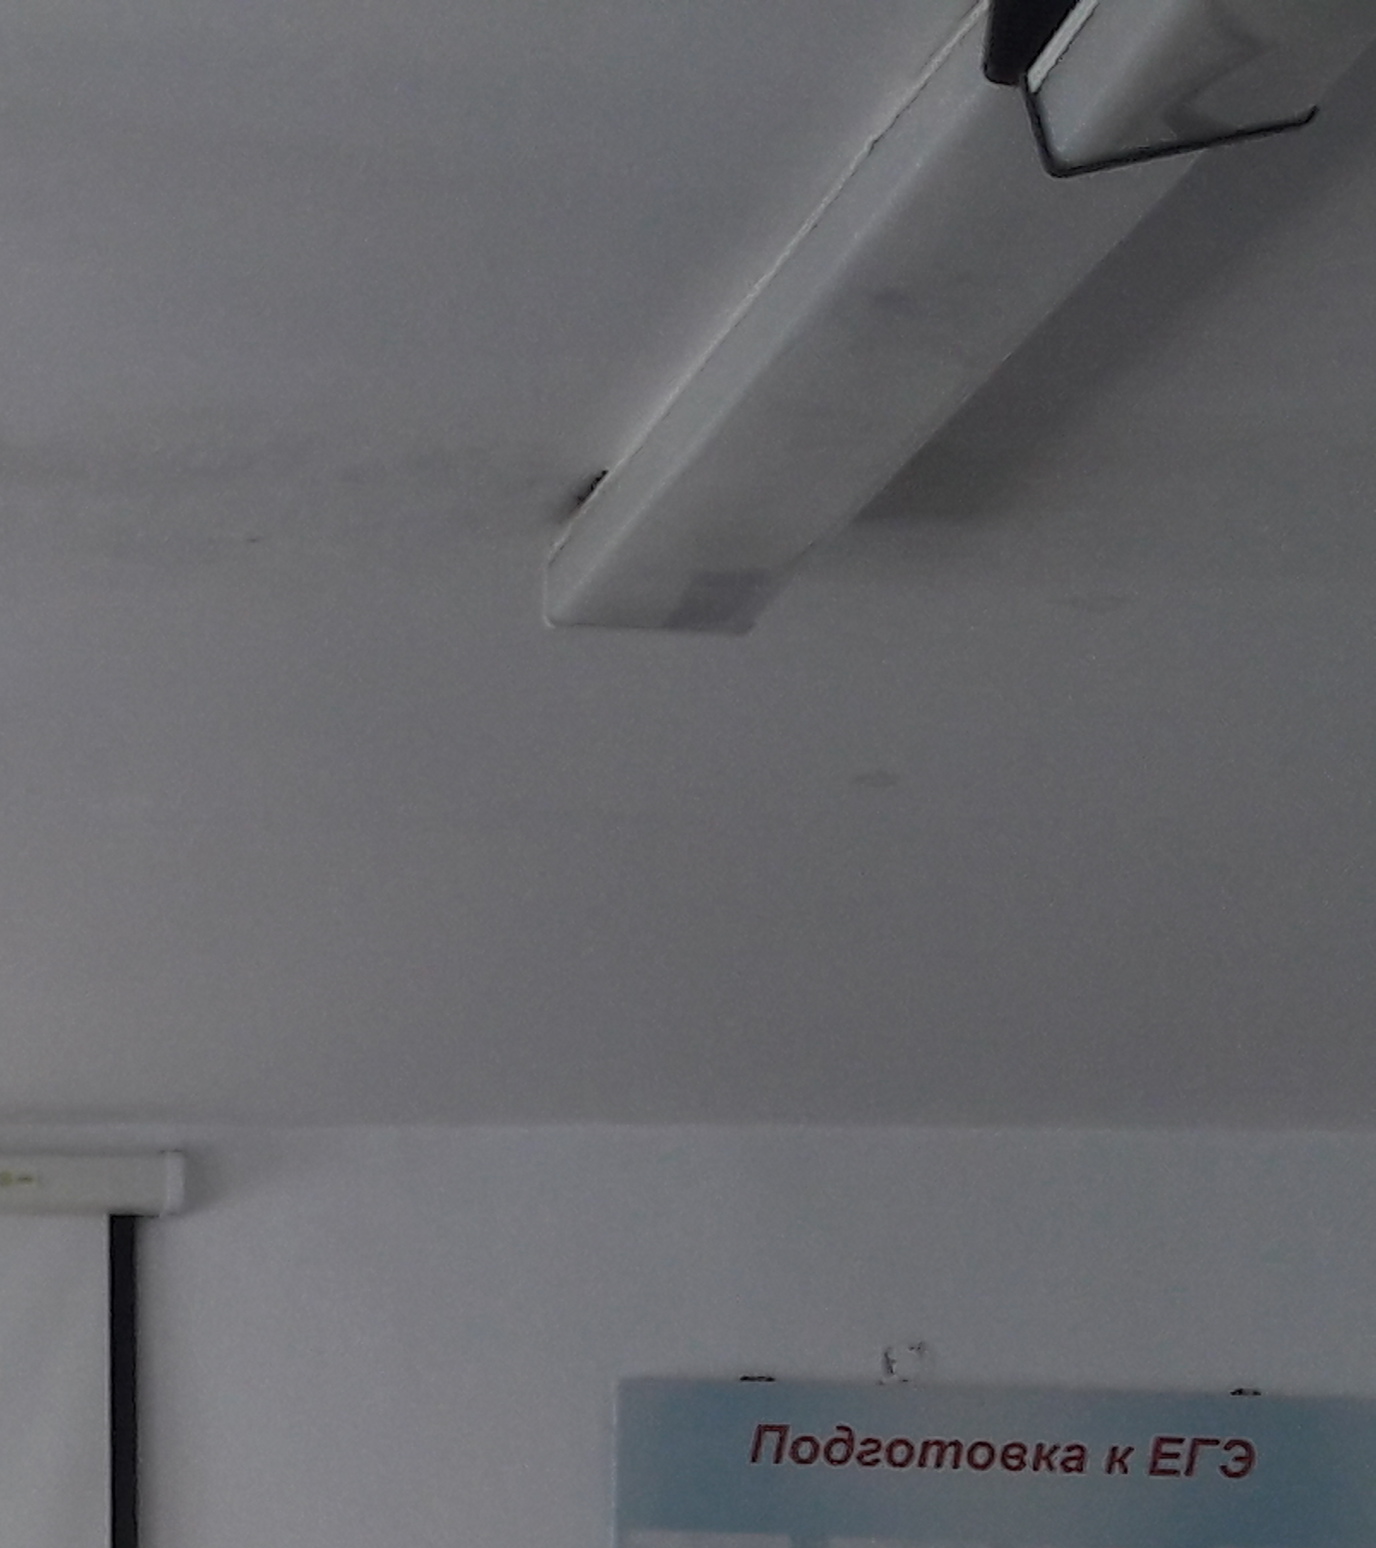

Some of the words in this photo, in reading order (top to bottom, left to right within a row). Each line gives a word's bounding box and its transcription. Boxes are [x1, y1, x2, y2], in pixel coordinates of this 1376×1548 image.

[748, 1423, 1087, 1474] Подготовка
[1105, 1445, 1135, 1476] к
[1148, 1436, 1257, 1480] ЕГЭ
